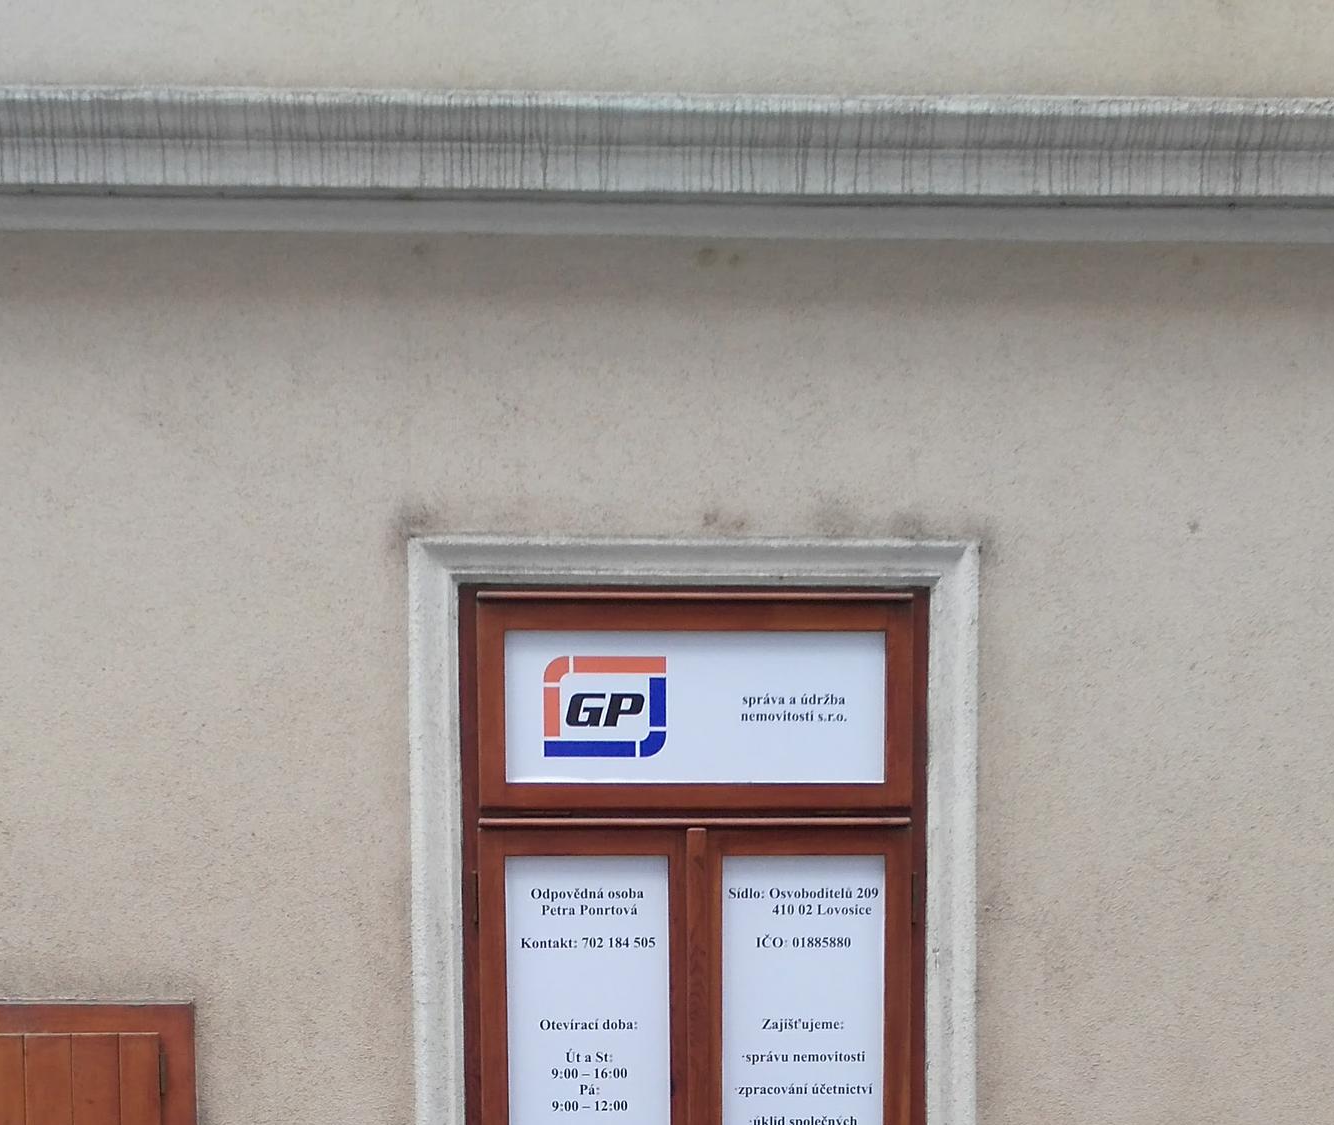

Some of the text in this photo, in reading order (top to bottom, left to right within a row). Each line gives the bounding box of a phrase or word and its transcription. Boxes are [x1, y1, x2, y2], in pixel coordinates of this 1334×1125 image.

[743, 693, 785, 708] správa
[801, 694, 845, 705] údržba
[565, 692, 645, 728] GP
[818, 714, 847, 722] s.r.o.
[531, 888, 643, 902] Odpovědná osoba
[729, 888, 878, 899] Sídlo: Osvoboditelů 209
[542, 905, 575, 915] Petra
[772, 904, 871, 915] 410 02 Lovosice
[522, 937, 655, 948] Kontakt: 702 184 505
[757, 934, 851, 948] IČO: 01885880
[540, 1019, 637, 1030] Otevírací doba:
[762, 1019, 843, 1032] Zajišťujeme:
[566, 1049, 580, 1063] Út
[596, 1052, 612, 1062] St:
[552, 1068, 578, 1079] 9:00
[595, 1068, 627, 1078] 16:00
[580, 1084, 599, 1095] Pá:
[812, 1083, 872, 1094] účetnictví
[552, 1101, 578, 1111] 9:00
[595, 1100, 627, 1111] 12:00
